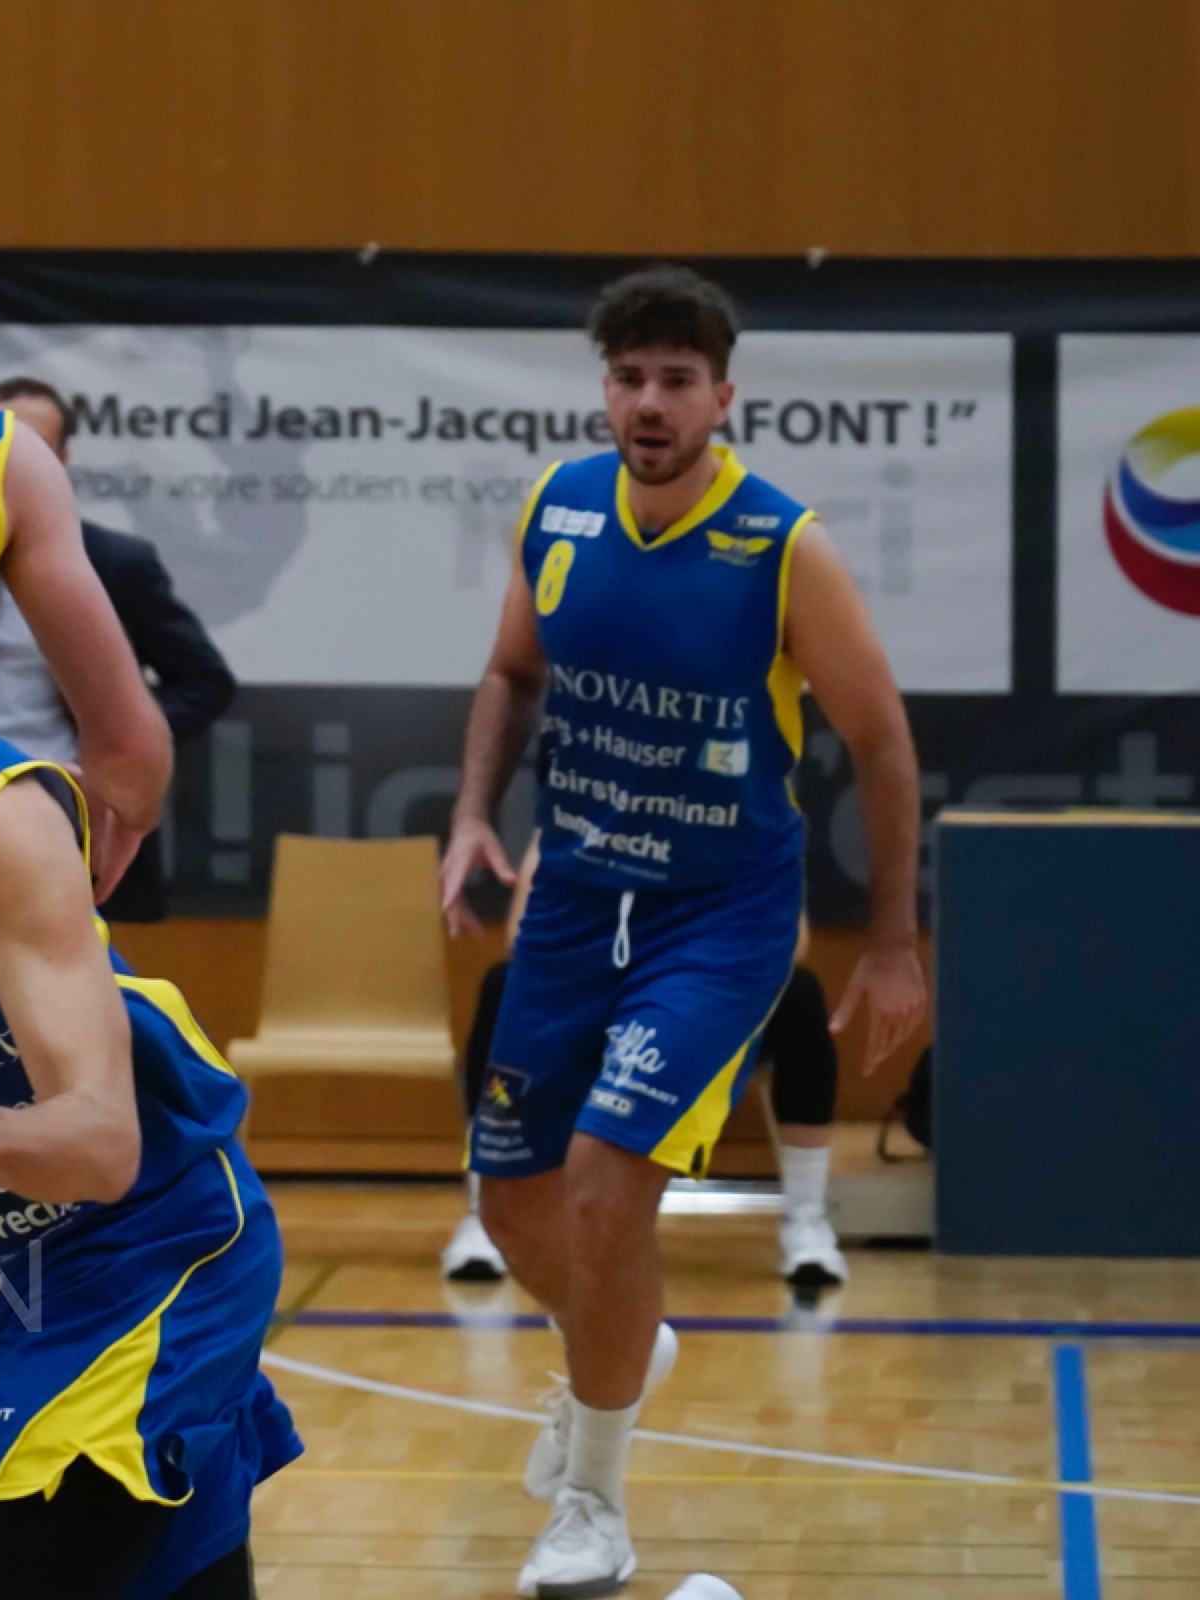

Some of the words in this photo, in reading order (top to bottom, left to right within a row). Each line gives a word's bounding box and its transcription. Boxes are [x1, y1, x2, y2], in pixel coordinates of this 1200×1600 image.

[72, 392, 230, 439] Merci
[536, 540, 575, 616] 8
[552, 663, 749, 729] NOVARTIS
